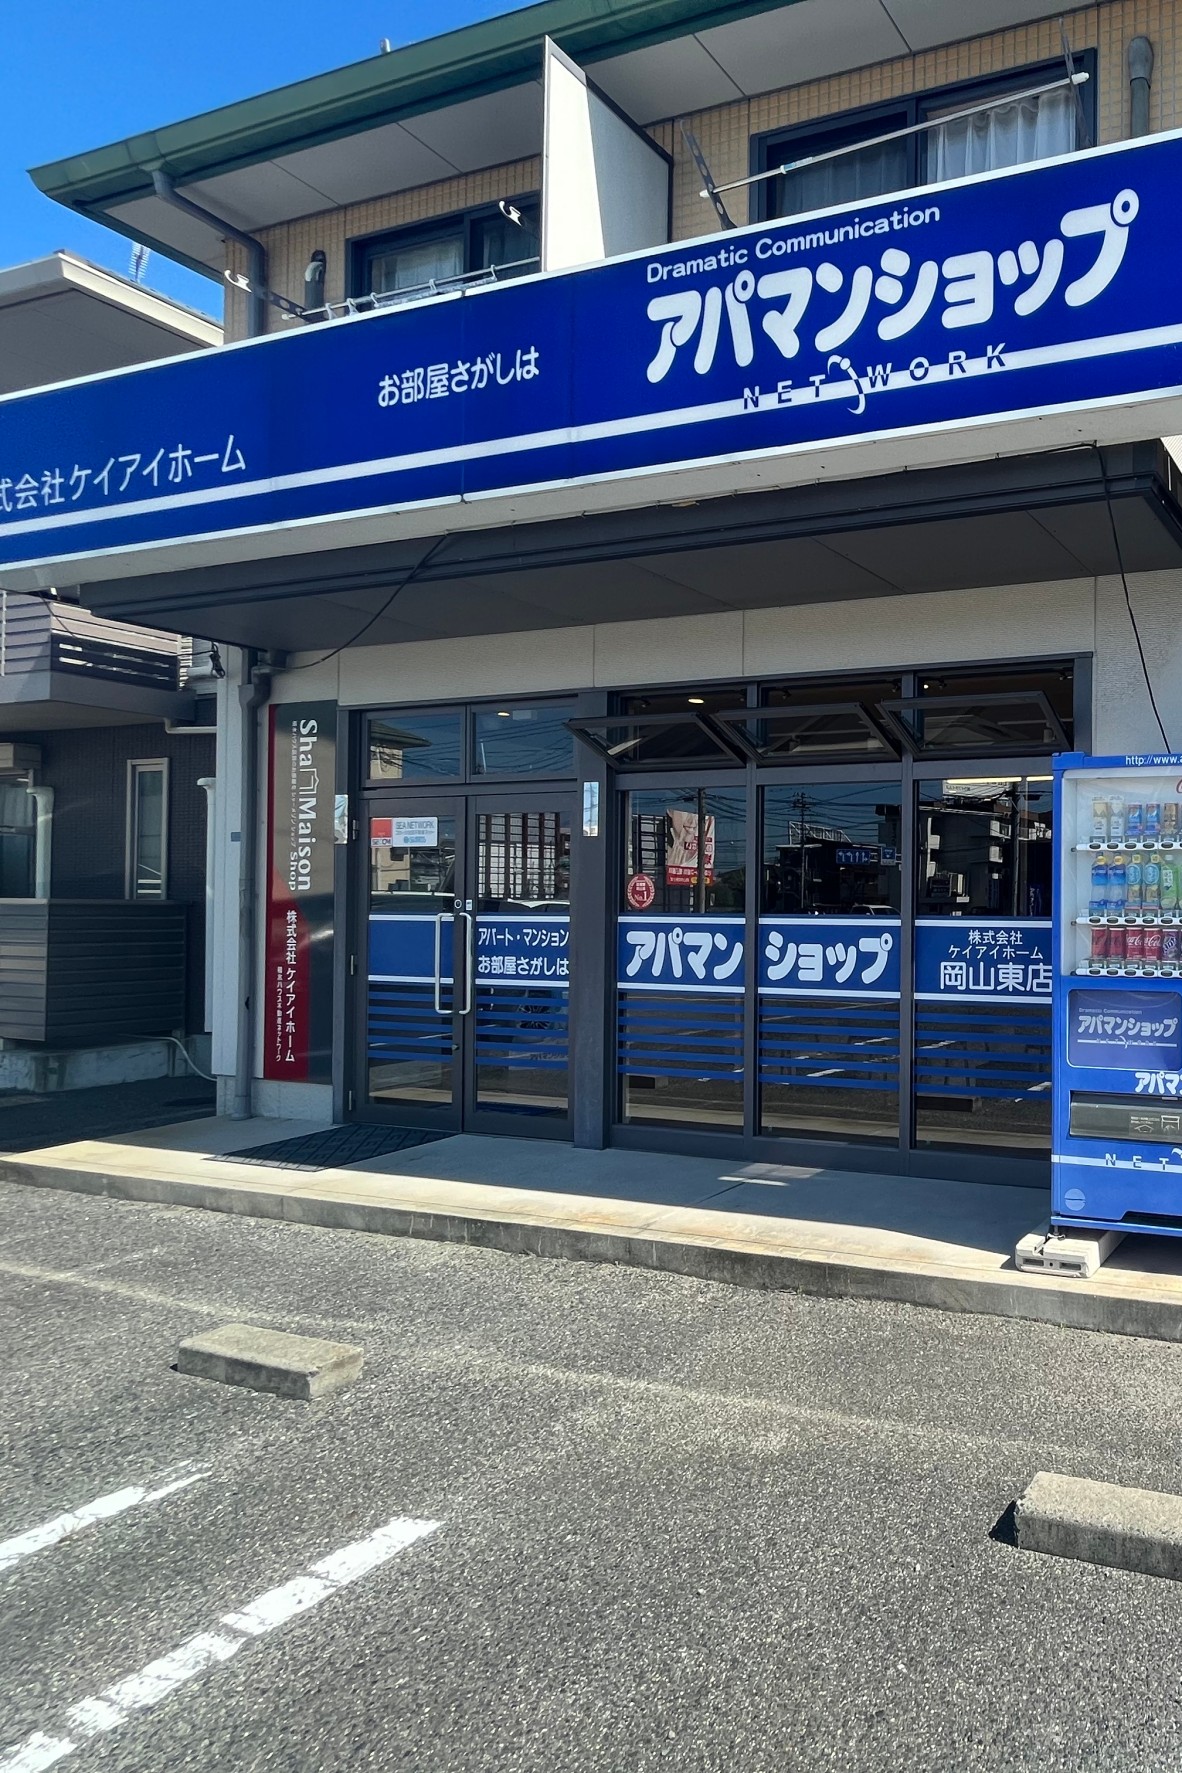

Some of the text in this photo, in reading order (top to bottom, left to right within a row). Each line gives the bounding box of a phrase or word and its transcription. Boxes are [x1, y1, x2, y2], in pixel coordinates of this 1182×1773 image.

[646, 206, 940, 284] Dramatic Communication
[646, 188, 1140, 384] アパマンショップ
[377, 346, 540, 408] お部屋さがしは
[743, 342, 1007, 410] NETWORK
[297, 719, 318, 891] Sha Maison
[288, 851, 299, 891] Shop
[478, 927, 570, 947] アパート・マンション
[625, 927, 894, 984] アパマン ショップ
[948, 944, 1044, 960] ケイアイホーム
[968, 929, 1024, 945] 株式会社
[284, 909, 298, 1063] 株式会社ケイアイホーム
[477, 955, 570, 976] お部屋さがしは
[940, 961, 1053, 993] 岡山東店
[1077, 1014, 1179, 1038] アパマンショップ
